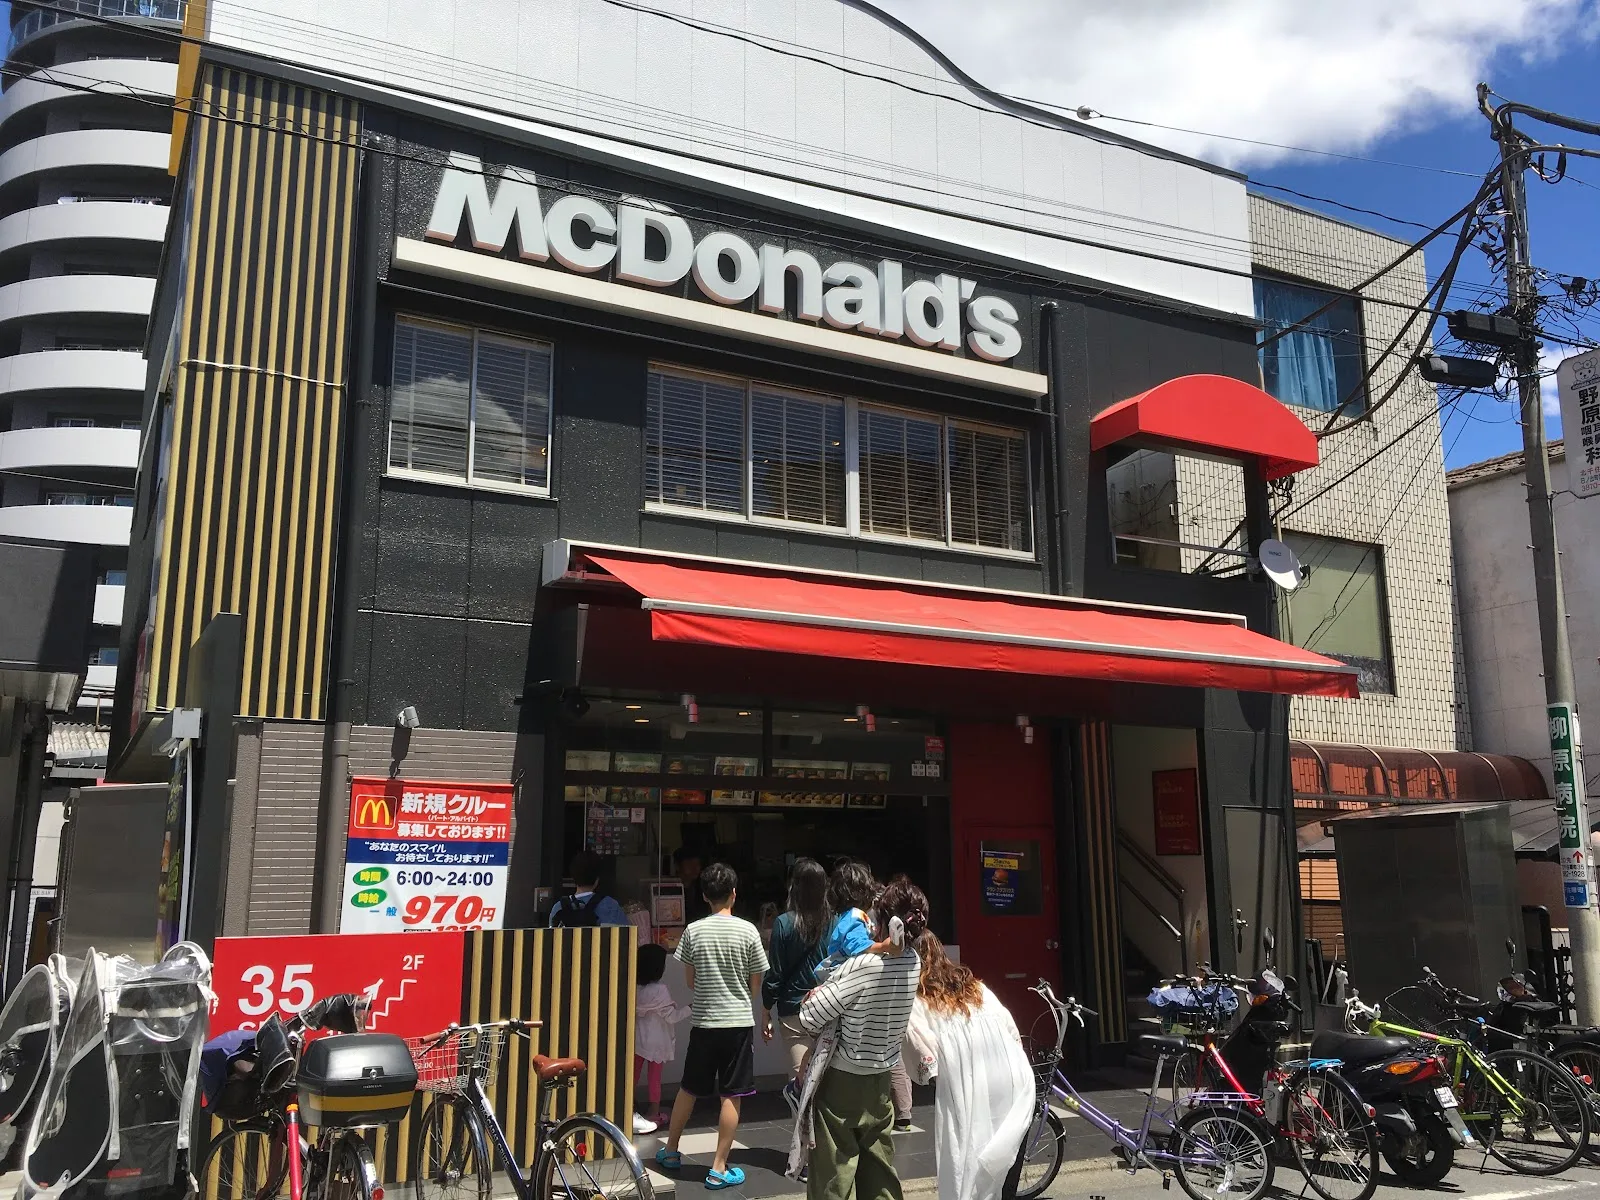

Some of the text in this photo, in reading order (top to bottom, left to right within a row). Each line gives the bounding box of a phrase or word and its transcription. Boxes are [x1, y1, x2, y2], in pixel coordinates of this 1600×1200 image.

[426, 149, 1023, 362] McDonald's
[1550, 715, 1577, 839] 柳原病院
[401, 792, 506, 815] 新規クルー
[397, 822, 507, 839] 募集しております!!
[402, 954, 425, 972] 2F
[237, 963, 315, 1016] 35
